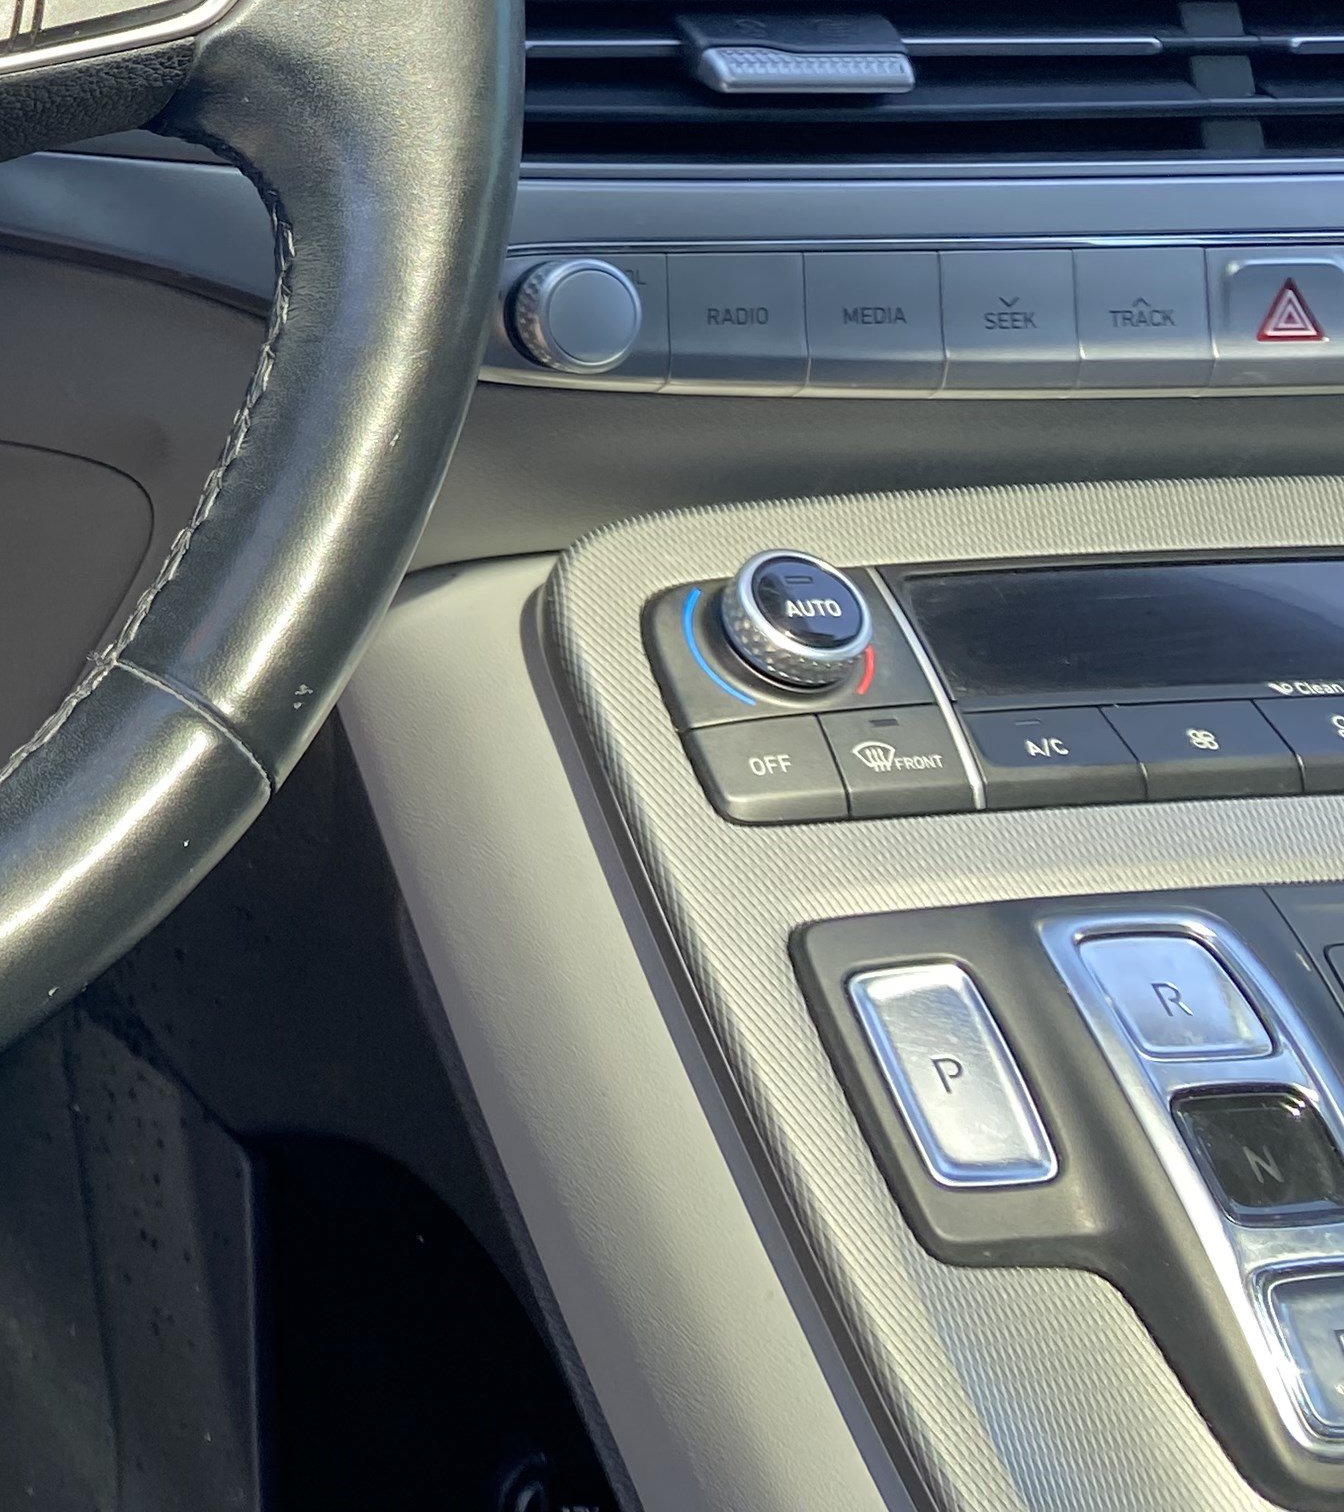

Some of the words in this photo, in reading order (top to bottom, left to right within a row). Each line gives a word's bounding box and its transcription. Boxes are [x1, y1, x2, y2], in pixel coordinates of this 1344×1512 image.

[707, 307, 769, 326] RADIO
[841, 304, 907, 327] MEDIA
[983, 308, 1037, 331] SEEK
[1109, 307, 1175, 329] TRACK
[785, 597, 843, 619] AUTO
[1294, 681, 1344, 695] Clean
[1025, 737, 1069, 757] A/C
[749, 753, 792, 778] OFF
[894, 752, 945, 772] FRONT
[1151, 982, 1193, 1016] R
[931, 1057, 962, 1094] P
[1243, 1145, 1284, 1185] N
